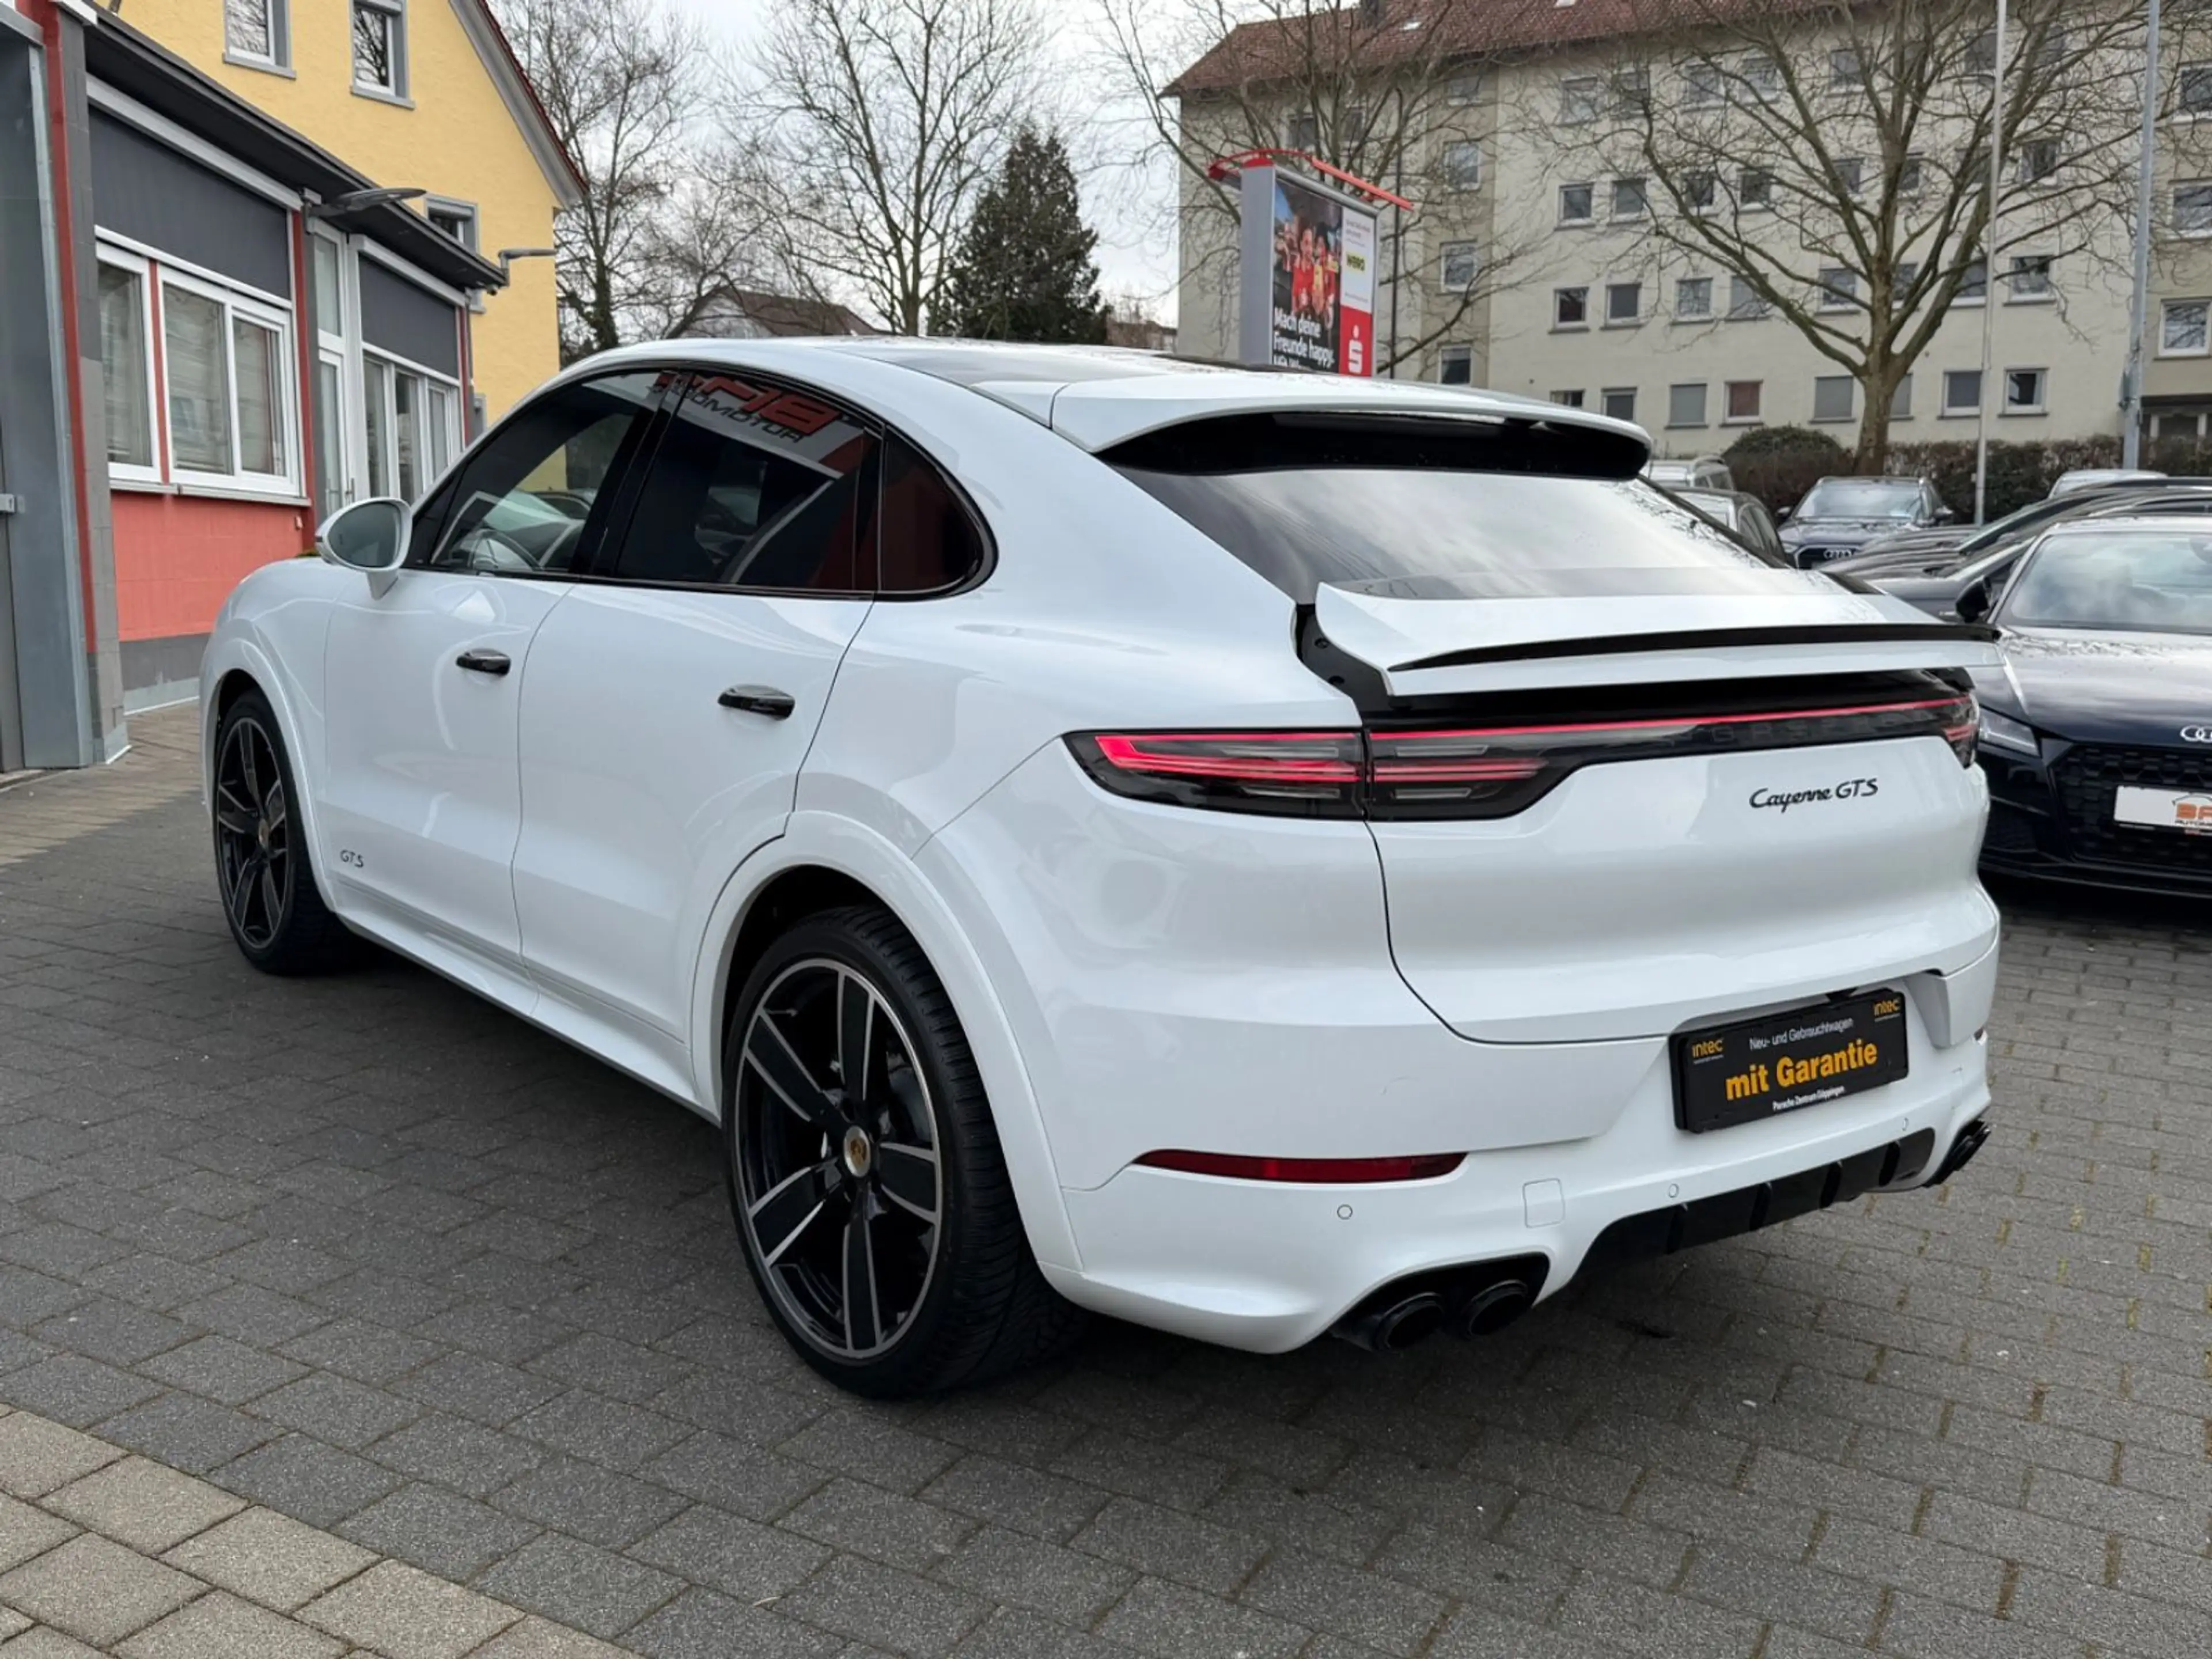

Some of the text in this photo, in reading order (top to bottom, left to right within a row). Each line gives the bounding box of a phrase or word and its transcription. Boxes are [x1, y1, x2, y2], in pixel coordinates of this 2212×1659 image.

[1275, 306, 1321, 338] Mach deine
[1274, 331, 1308, 358] Freunde
[1749, 778, 1878, 813] Cayenne GTS
[340, 849, 363, 868] GTS
[1692, 1039, 1723, 1058] intec
[1749, 1037, 1771, 1051] Neu-
[1772, 1029, 1787, 1046] und
[1725, 1038, 1878, 1100] mit Garantie
